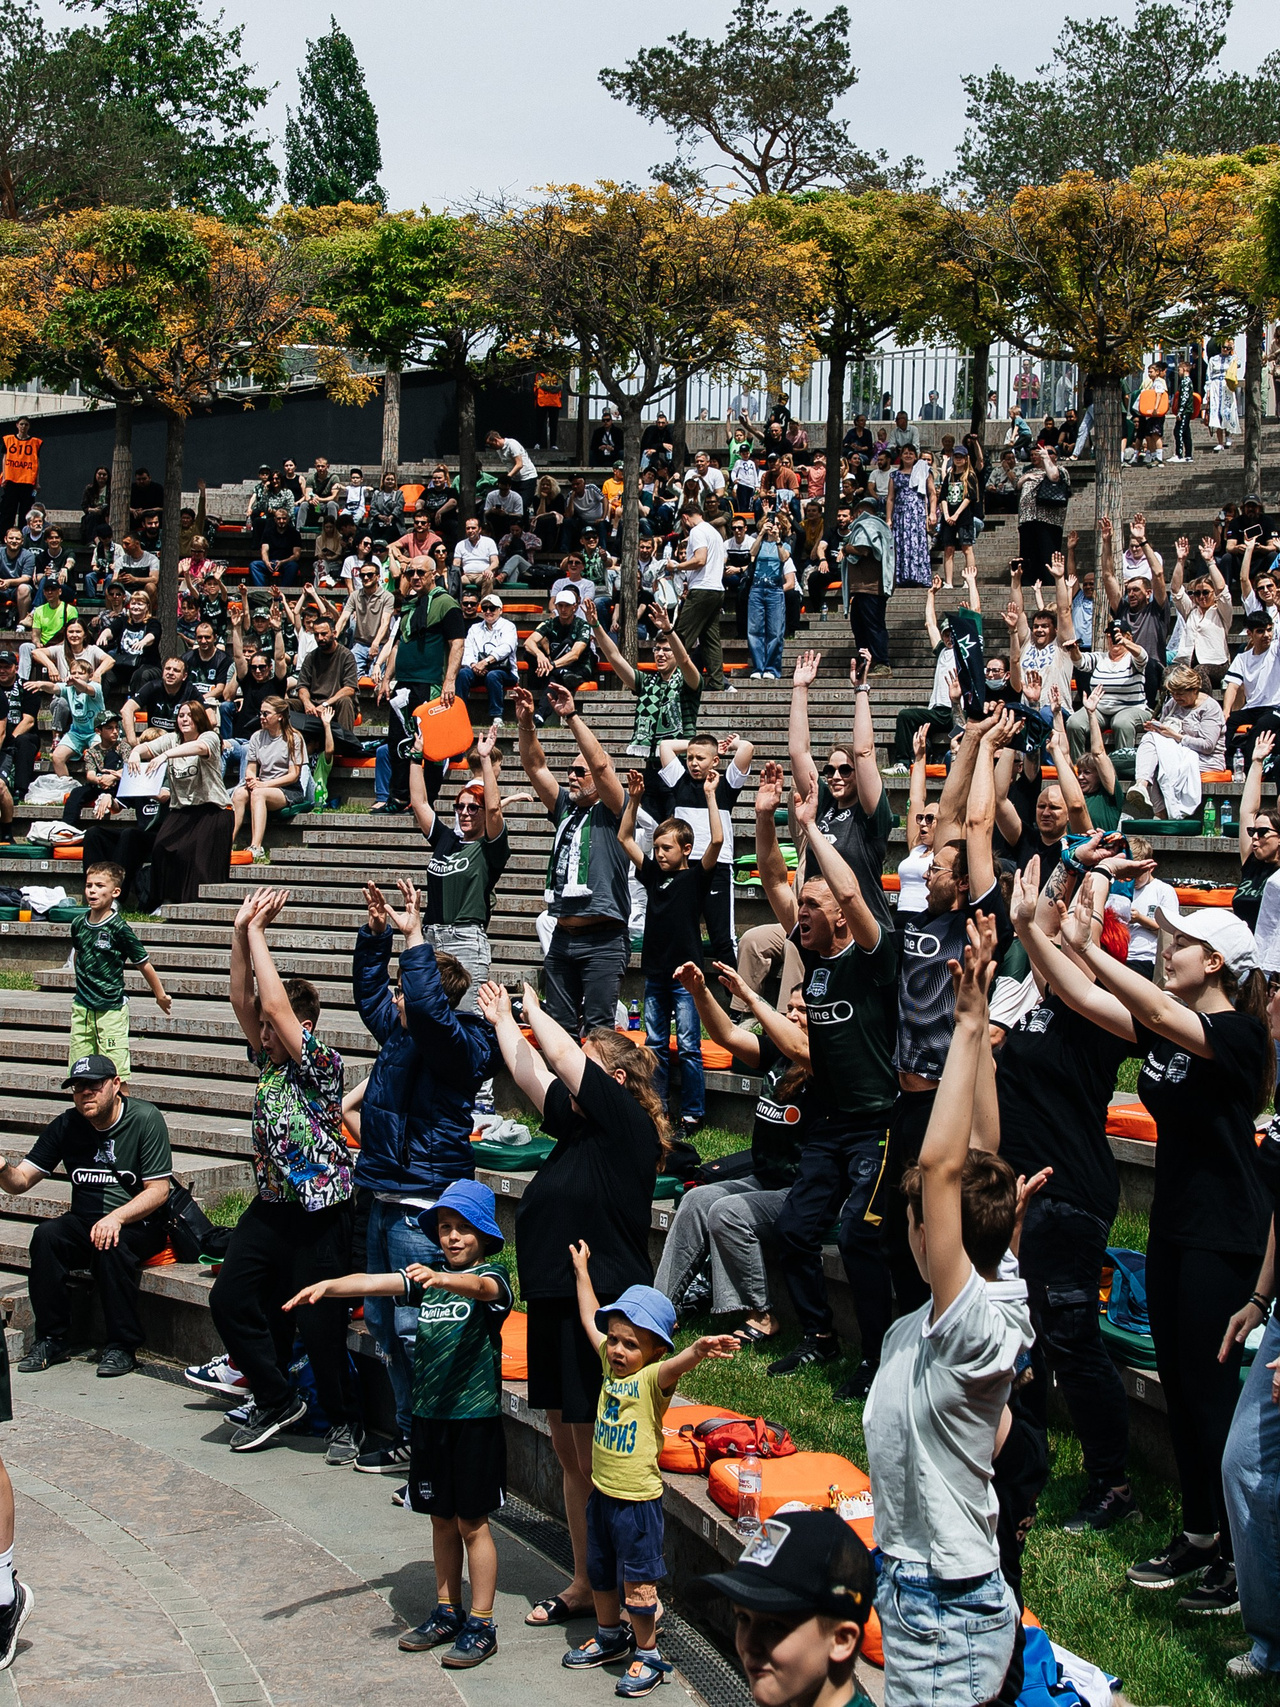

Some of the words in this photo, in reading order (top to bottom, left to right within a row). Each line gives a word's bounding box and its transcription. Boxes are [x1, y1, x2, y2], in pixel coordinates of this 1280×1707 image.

[9, 443, 32, 456] 610
[5, 459, 33, 470] СТЮАРД
[661, 1214, 668, 1226] 27
[602, 1396, 621, 1424] Я
